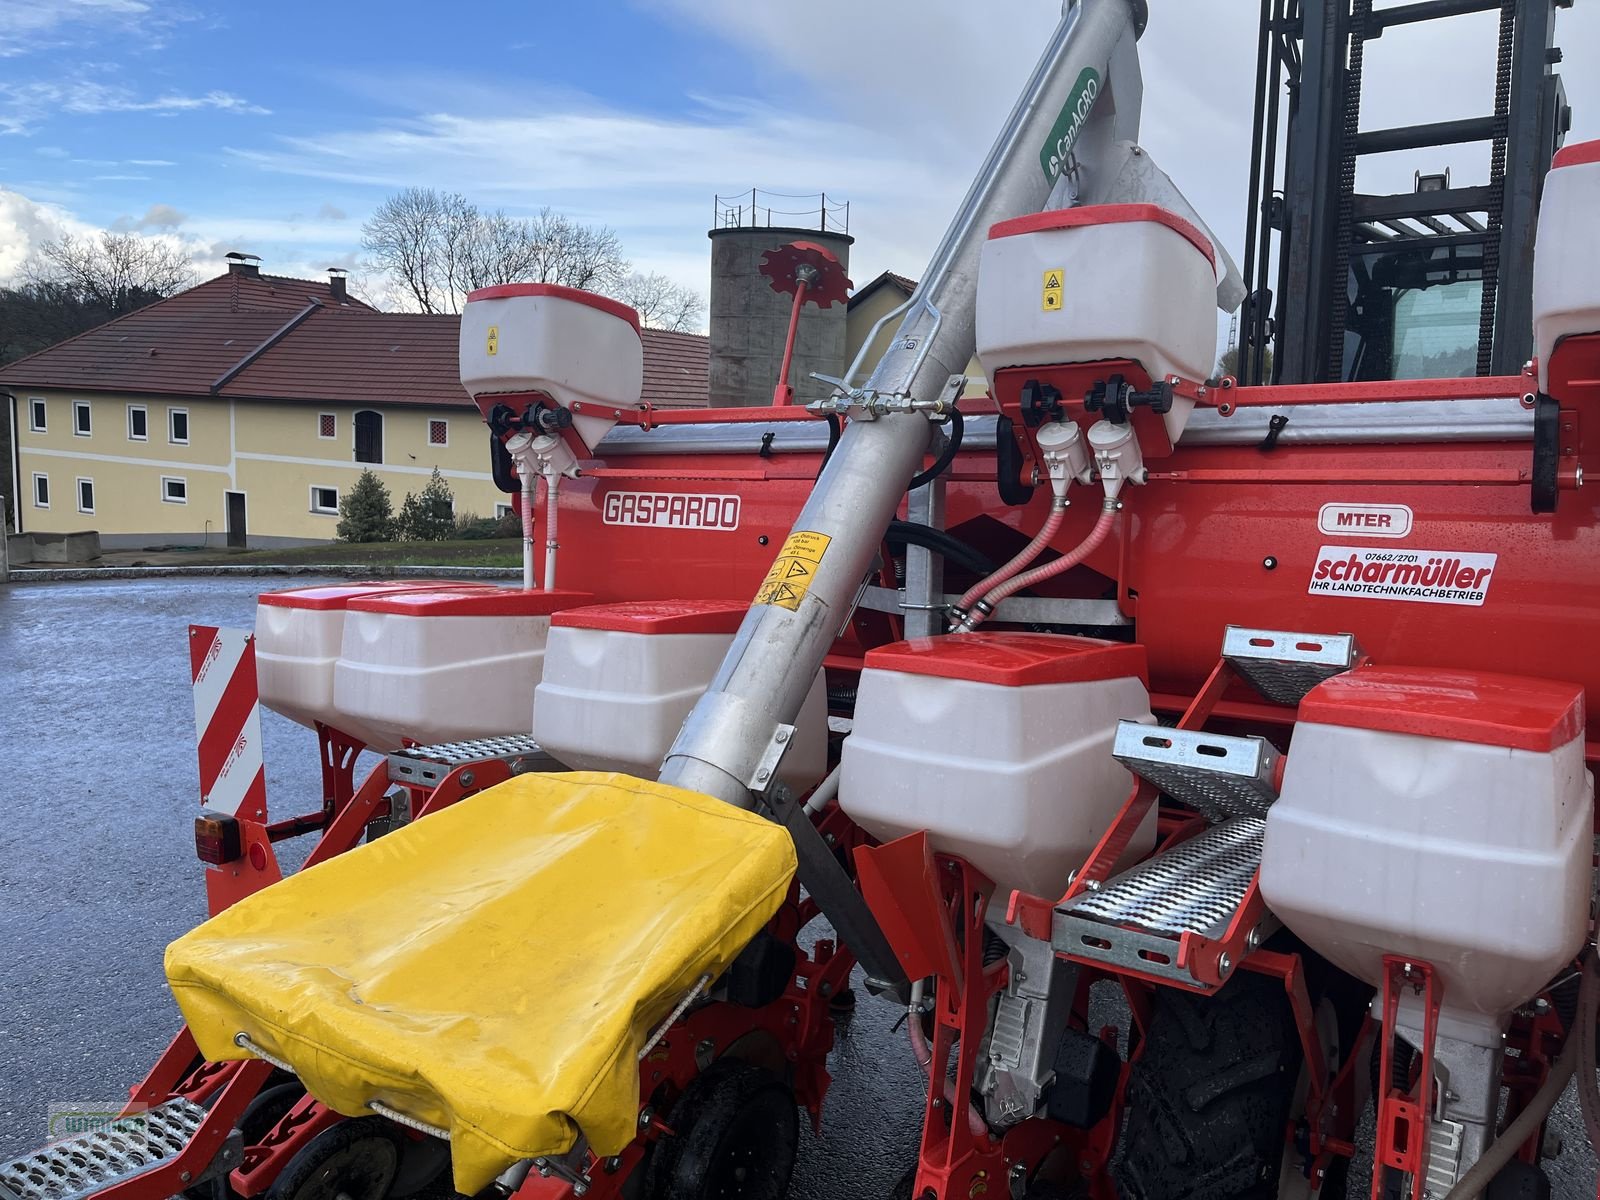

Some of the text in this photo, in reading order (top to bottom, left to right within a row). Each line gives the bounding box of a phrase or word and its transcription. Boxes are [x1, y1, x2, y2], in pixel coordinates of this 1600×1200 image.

[1057, 78, 1097, 161] CanAGRO
[604, 494, 739, 528] GASPARDO
[1337, 512, 1392, 528] MTER
[1365, 552, 1419, 563] 07662/2701
[1314, 553, 1492, 590] scharmüller
[1310, 581, 1484, 601] IHR LANDTECHNIKFACHBETRIEB
